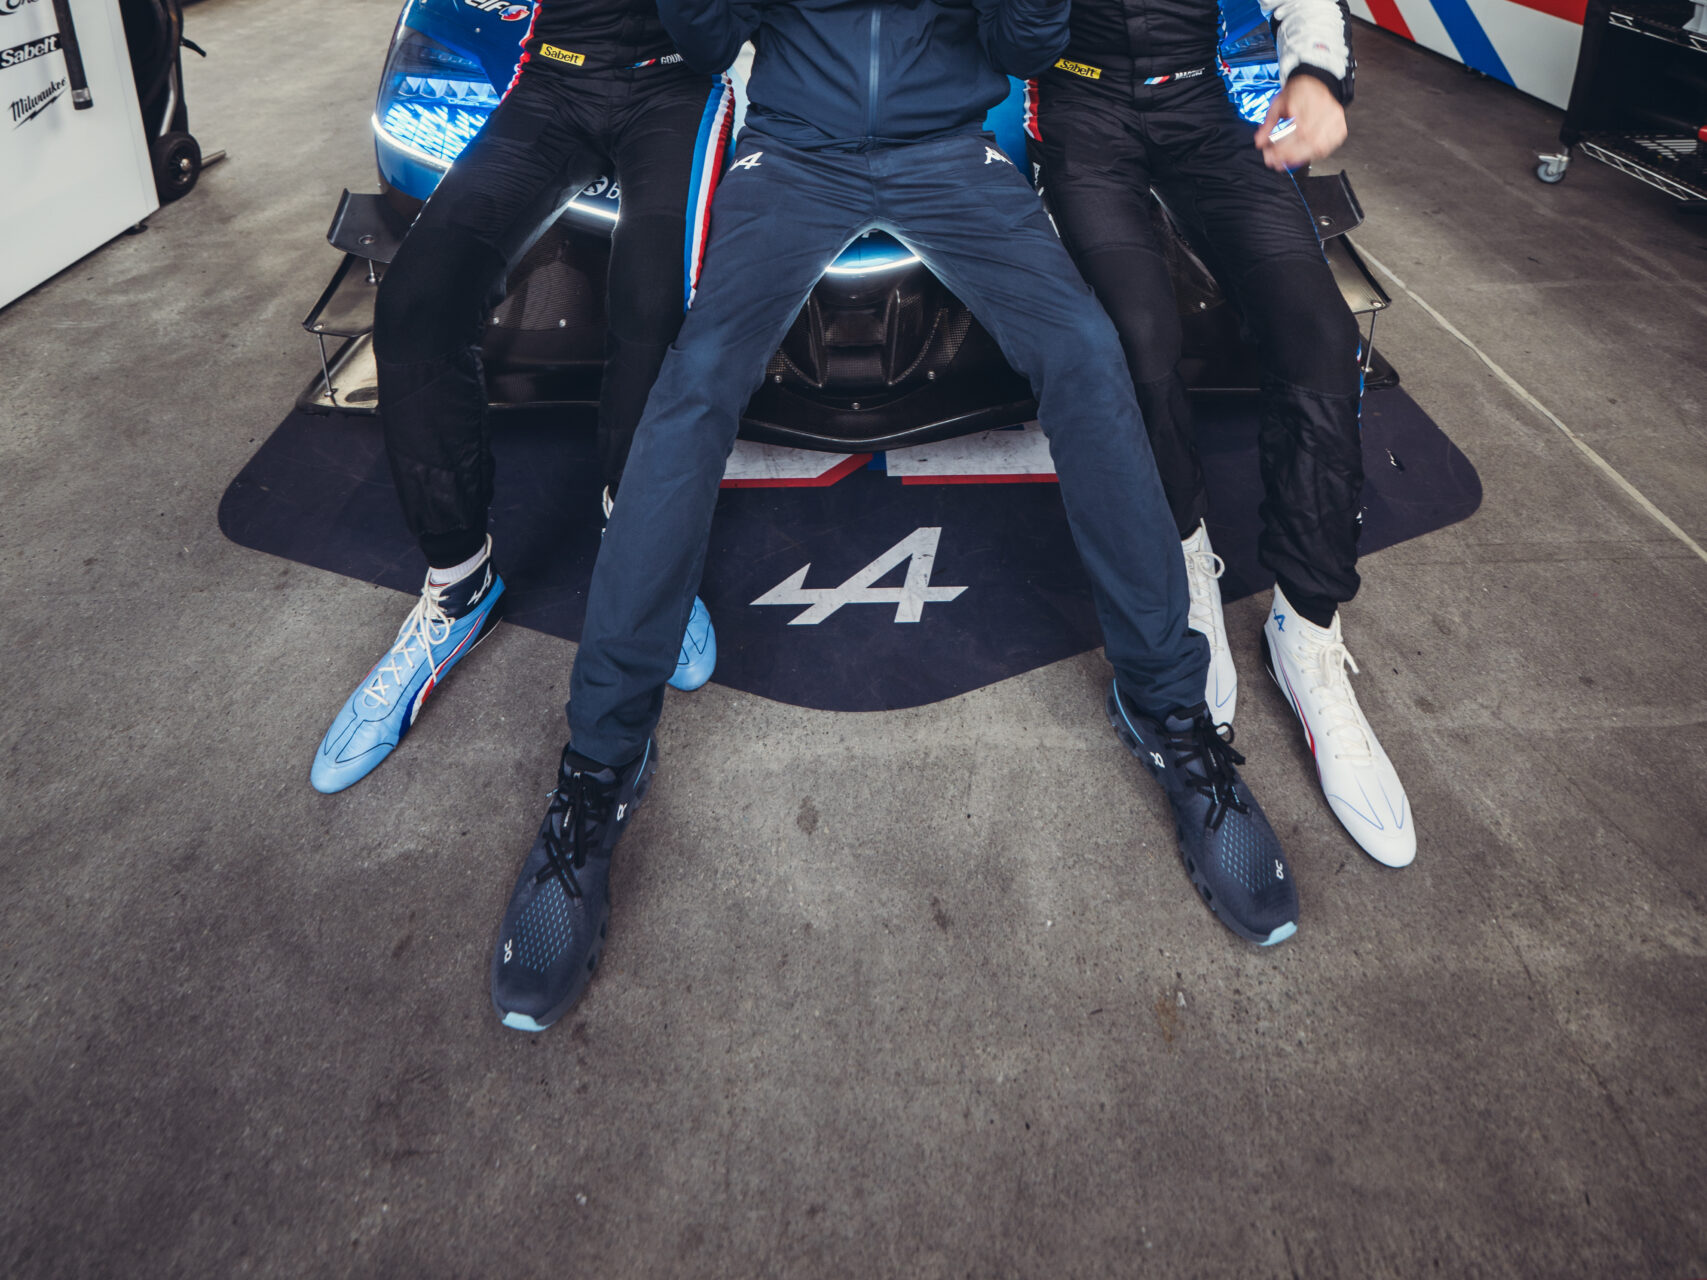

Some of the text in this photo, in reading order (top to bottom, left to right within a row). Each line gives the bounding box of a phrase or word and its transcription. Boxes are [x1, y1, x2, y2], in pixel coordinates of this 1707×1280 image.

[1, 35, 58, 68] Sabelt
[544, 45, 580, 64] Sabelt
[1059, 60, 1095, 77] Sabelt
[8, 76, 66, 123] Milwaukee
